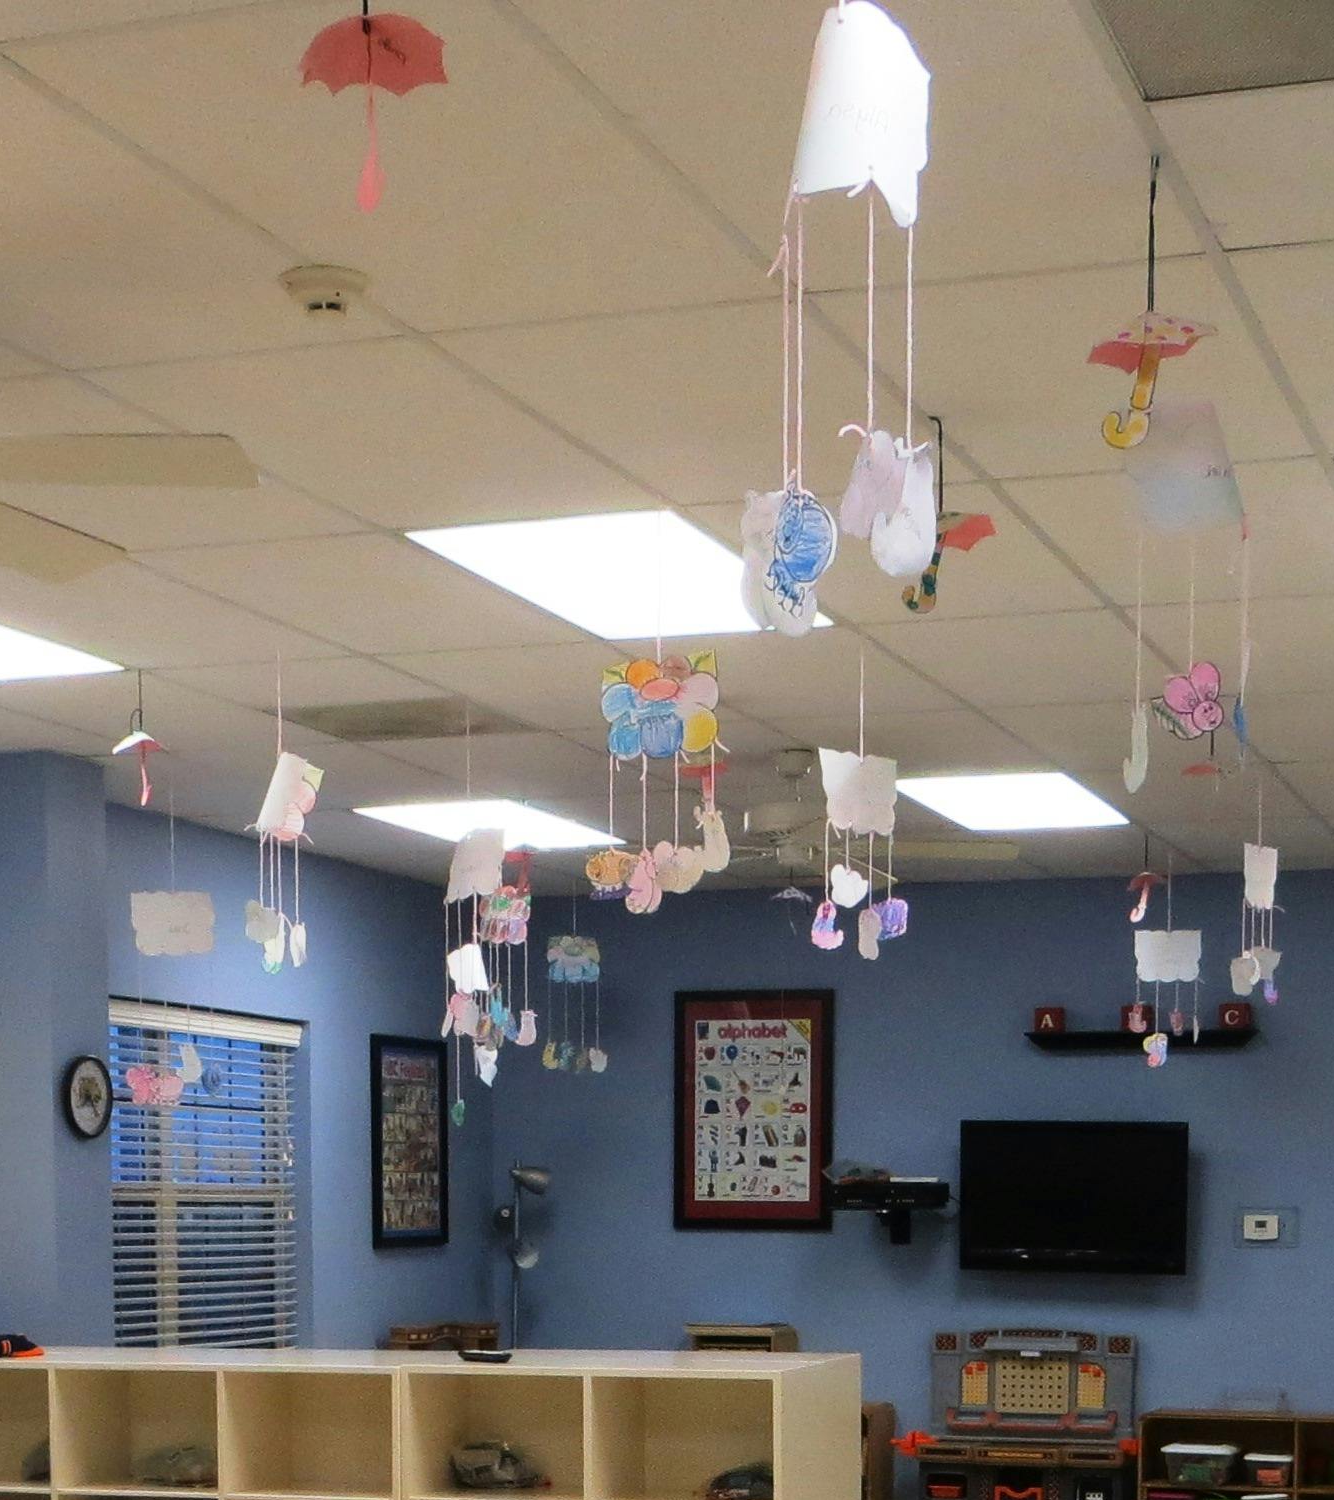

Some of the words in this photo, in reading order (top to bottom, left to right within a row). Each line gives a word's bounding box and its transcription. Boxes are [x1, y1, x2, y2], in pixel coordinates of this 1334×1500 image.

[1040, 1013, 1055, 1029] A
[1224, 1009, 1240, 1025] C
[718, 1021, 788, 1043] alphabet
